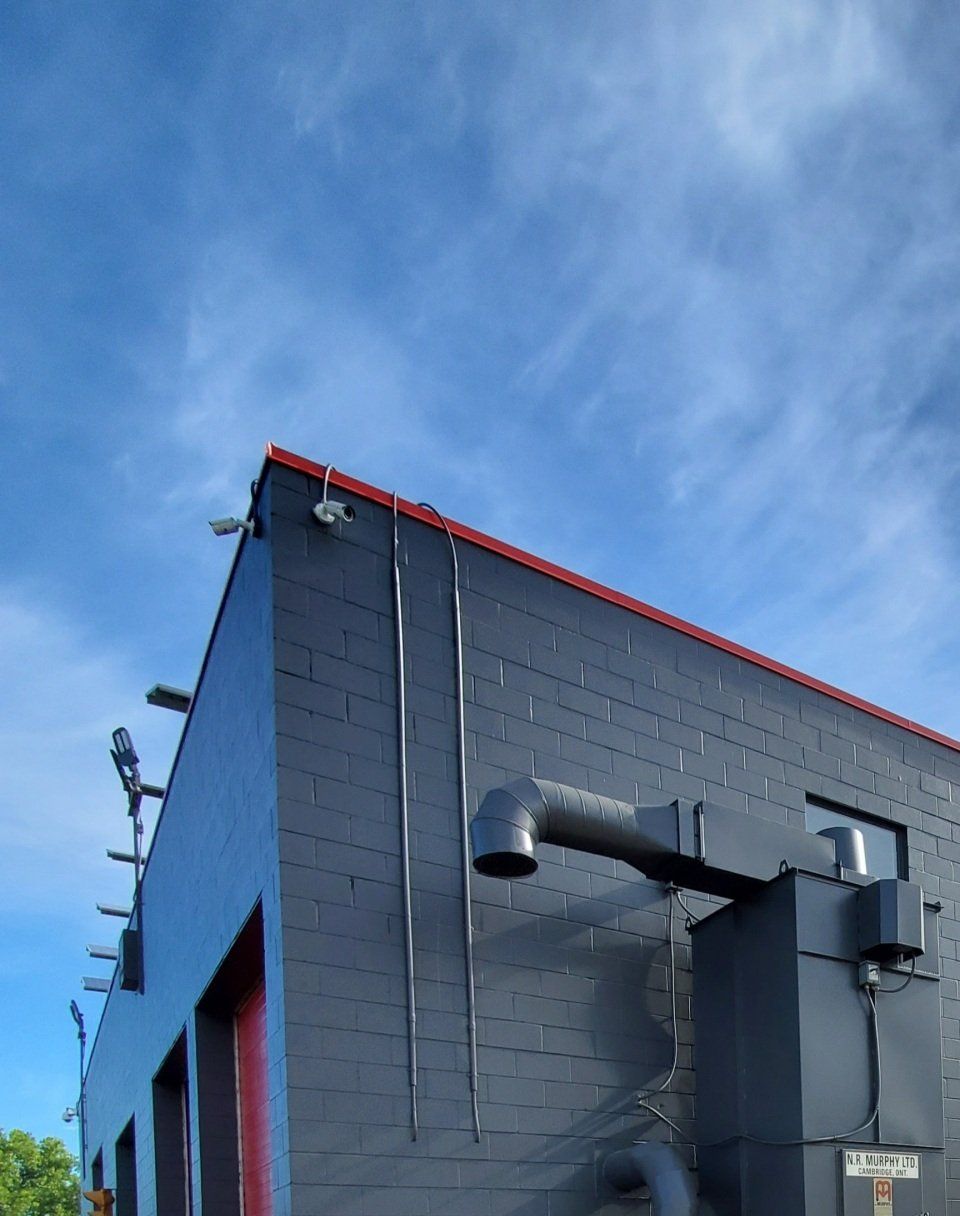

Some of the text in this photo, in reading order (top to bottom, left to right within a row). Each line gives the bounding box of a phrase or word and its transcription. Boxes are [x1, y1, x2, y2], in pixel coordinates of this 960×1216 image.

[847, 1153, 918, 1169] N.R. MURPHY LTD.
[858, 1167, 894, 1177] CAMBRIDGE,
